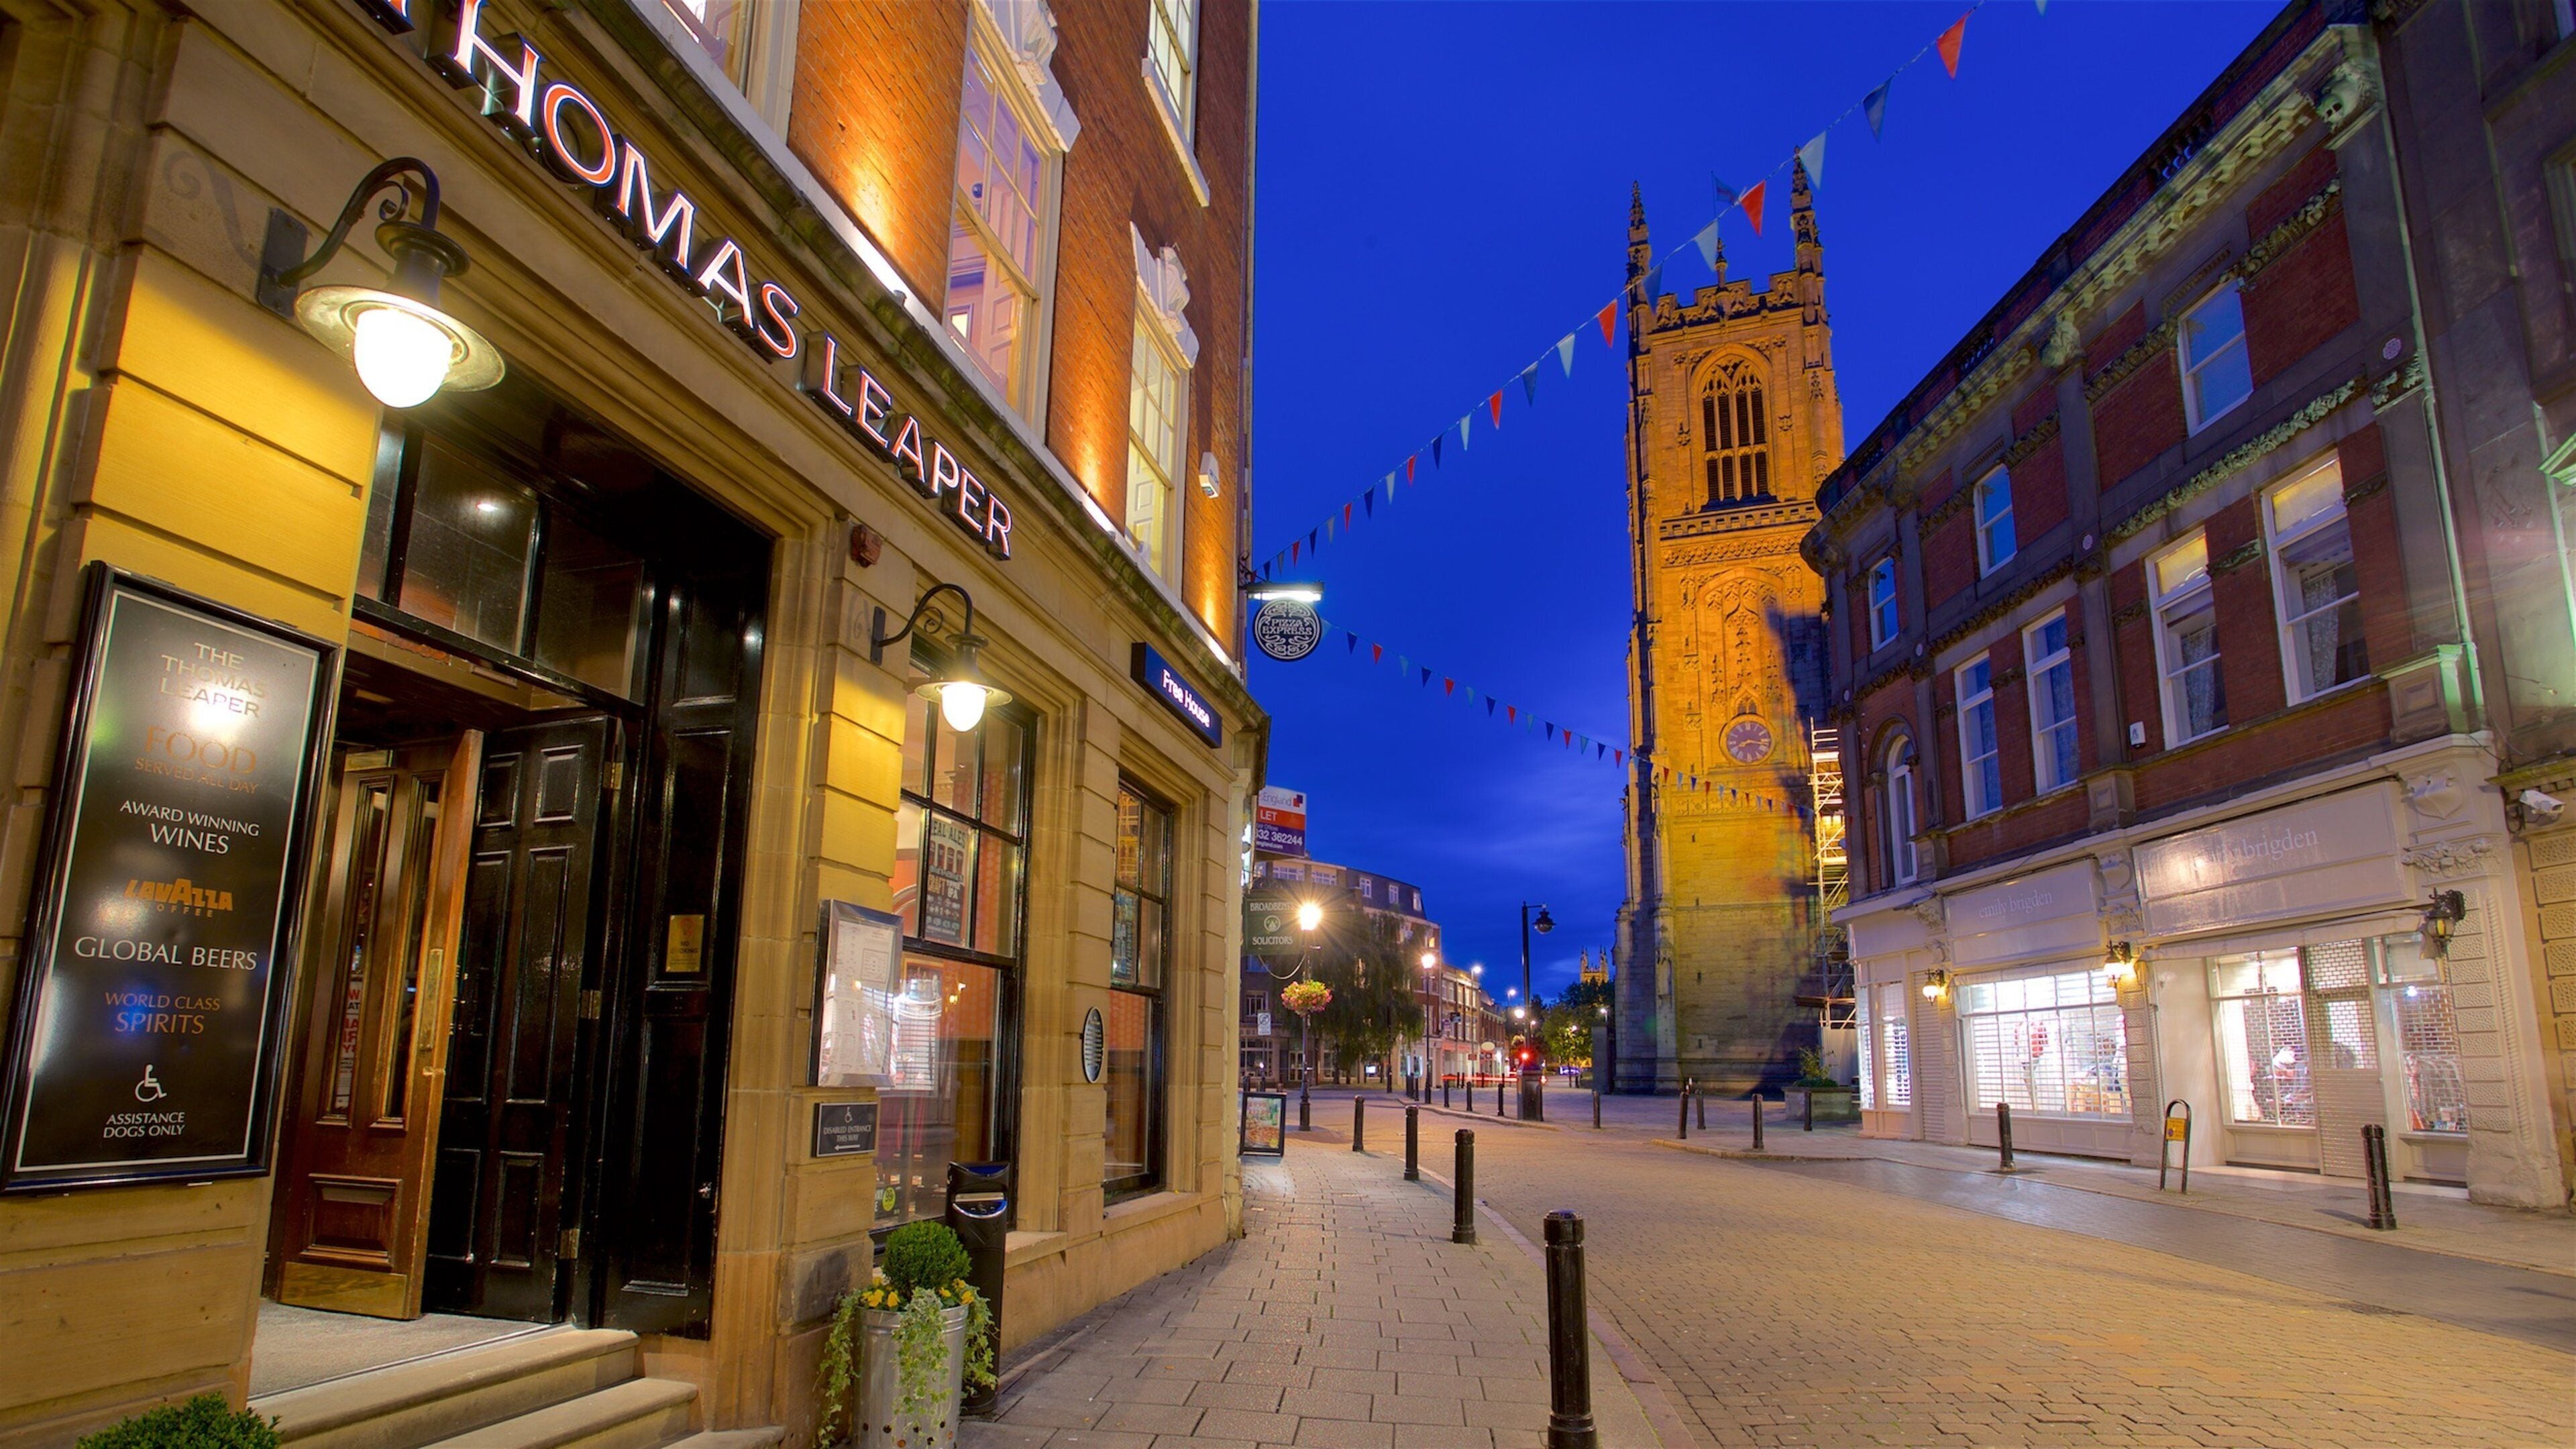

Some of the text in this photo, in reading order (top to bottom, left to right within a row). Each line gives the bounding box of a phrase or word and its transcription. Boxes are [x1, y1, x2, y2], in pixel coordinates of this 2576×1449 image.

[386, 0, 1012, 557] HOMAS LEAPER
[1262, 626, 1312, 635] EXPRESS
[1271, 619, 1303, 627] PIZZA
[194, 642, 244, 670] THE
[160, 654, 266, 699] THOMAS
[159, 677, 260, 718] LEAPER
[1163, 669, 1210, 728] Free House
[144, 725, 257, 775] FOOD
[135, 757, 259, 795] SERVED ALL DAY
[119, 800, 260, 837] AWARD WINNING
[1260, 809, 1277, 822] LET
[150, 822, 230, 855] WINES
[932, 820, 966, 849] EAL ALES
[1271, 831, 1303, 845] 362244
[2242, 826, 2318, 861] brigden
[123, 878, 233, 911] LAVAZZA
[1979, 889, 2053, 920] emily brigden
[74, 936, 258, 971] GLOBAL BEERS
[1252, 936, 1293, 945] SOLICITORS
[105, 991, 221, 1012] WORLD CLASS
[115, 1012, 205, 1035] SPIRITS
[103, 1124, 186, 1138] DOGS ONLY
[106, 1112, 185, 1126] ASSISTANCE
[823, 1124, 871, 1134] DISABLED ENTRANCE
[836, 1134, 847, 1142] THIS
